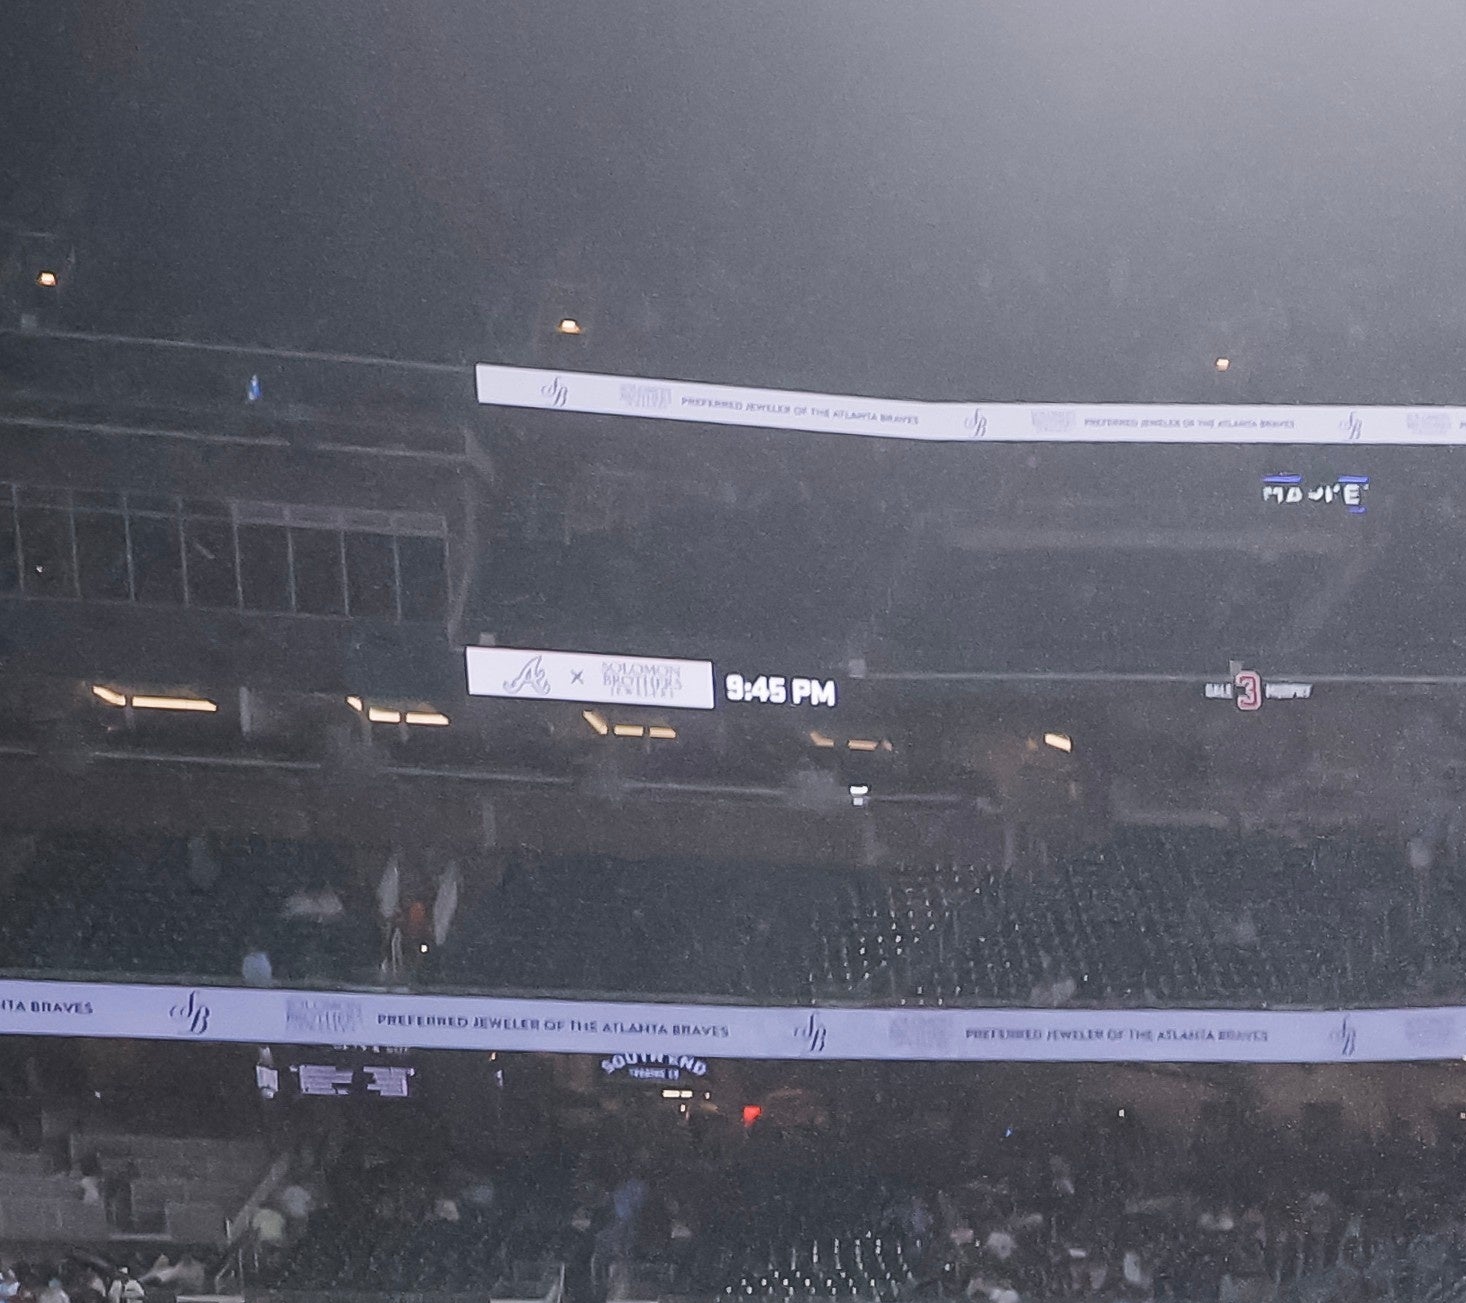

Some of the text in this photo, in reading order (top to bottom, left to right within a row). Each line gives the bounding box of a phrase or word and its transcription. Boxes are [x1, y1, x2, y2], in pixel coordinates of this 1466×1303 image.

[725, 673, 836, 706] 9:45 PM
[1235, 671, 1262, 710] 3
[542, 1020, 562, 1033] OF
[570, 1021, 598, 1034] THE
